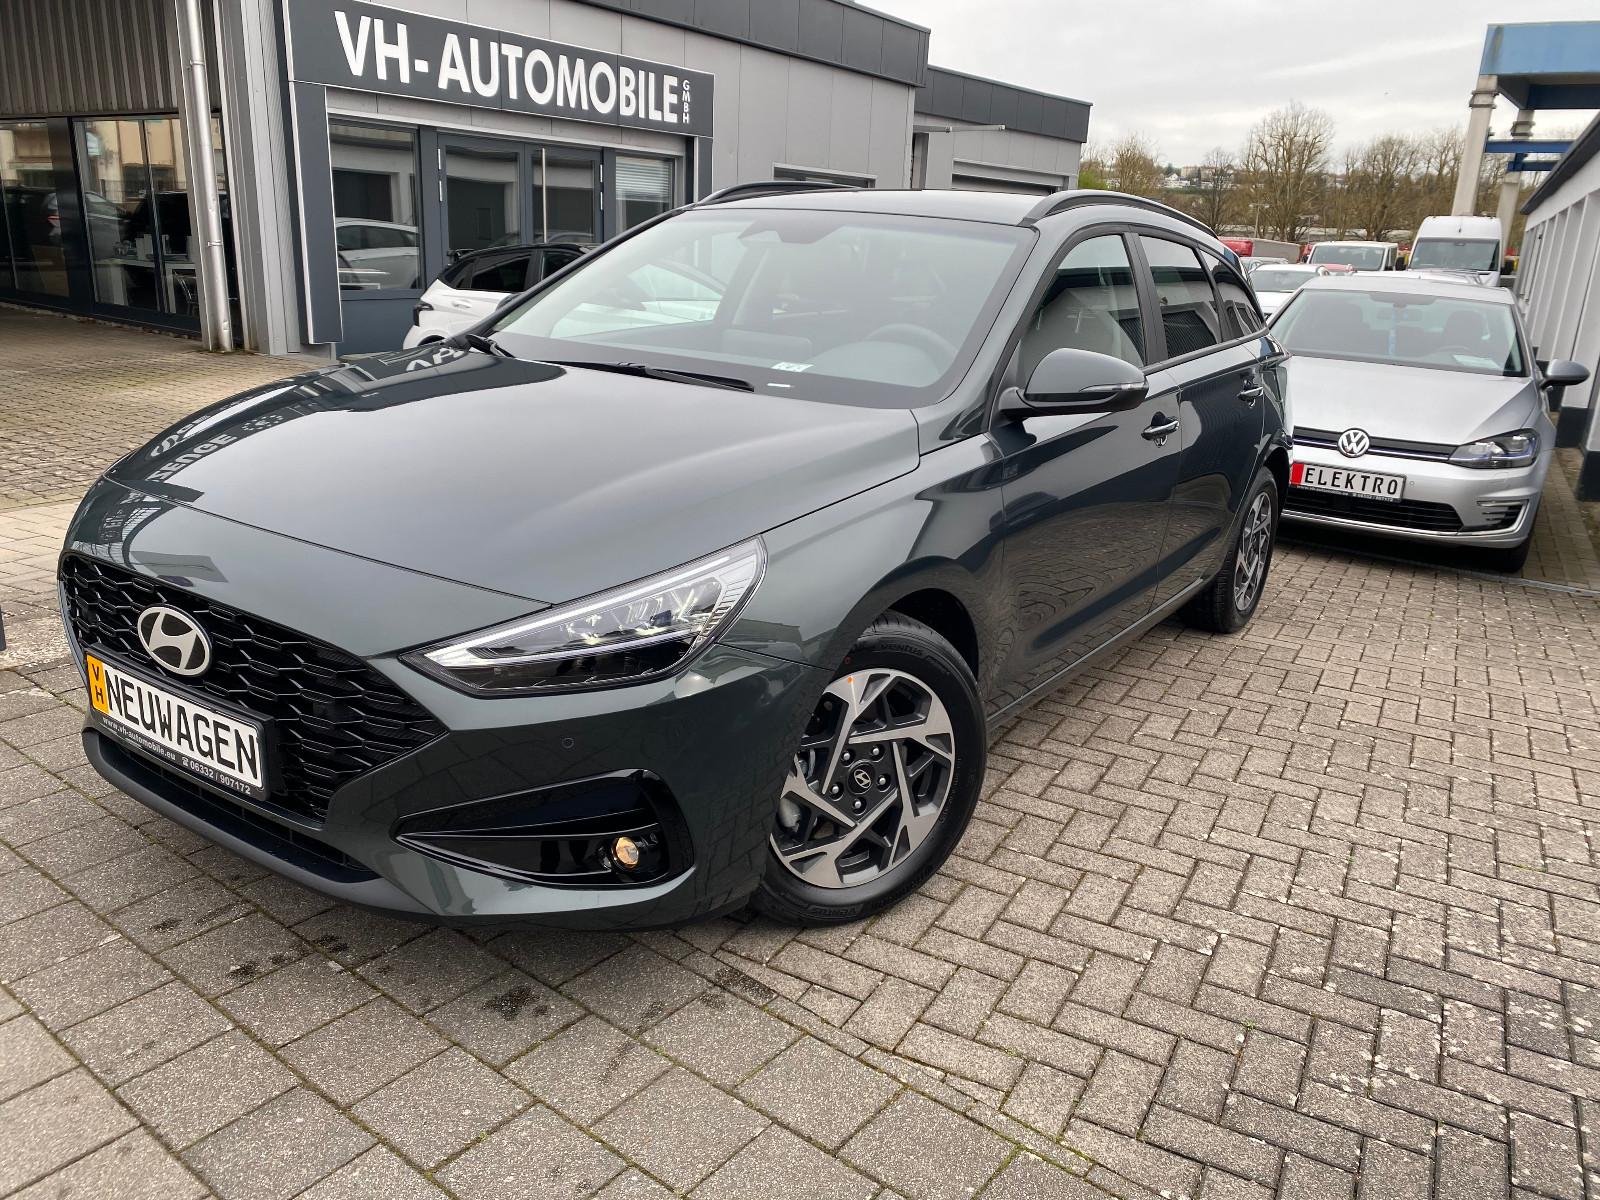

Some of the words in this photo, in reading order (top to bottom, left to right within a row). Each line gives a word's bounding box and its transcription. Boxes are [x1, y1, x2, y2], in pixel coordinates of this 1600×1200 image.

[438, 32, 678, 124] AUTOMOBILE
[682, 79, 691, 124] GMBH
[1304, 467, 1398, 495] ELEKTRO
[102, 718, 176, 761] www.vh-automobile.eu
[190, 761, 214, 779] 06332
[220, 772, 251, 795] 907172
[104, 669, 258, 780] NEUWAGEN
